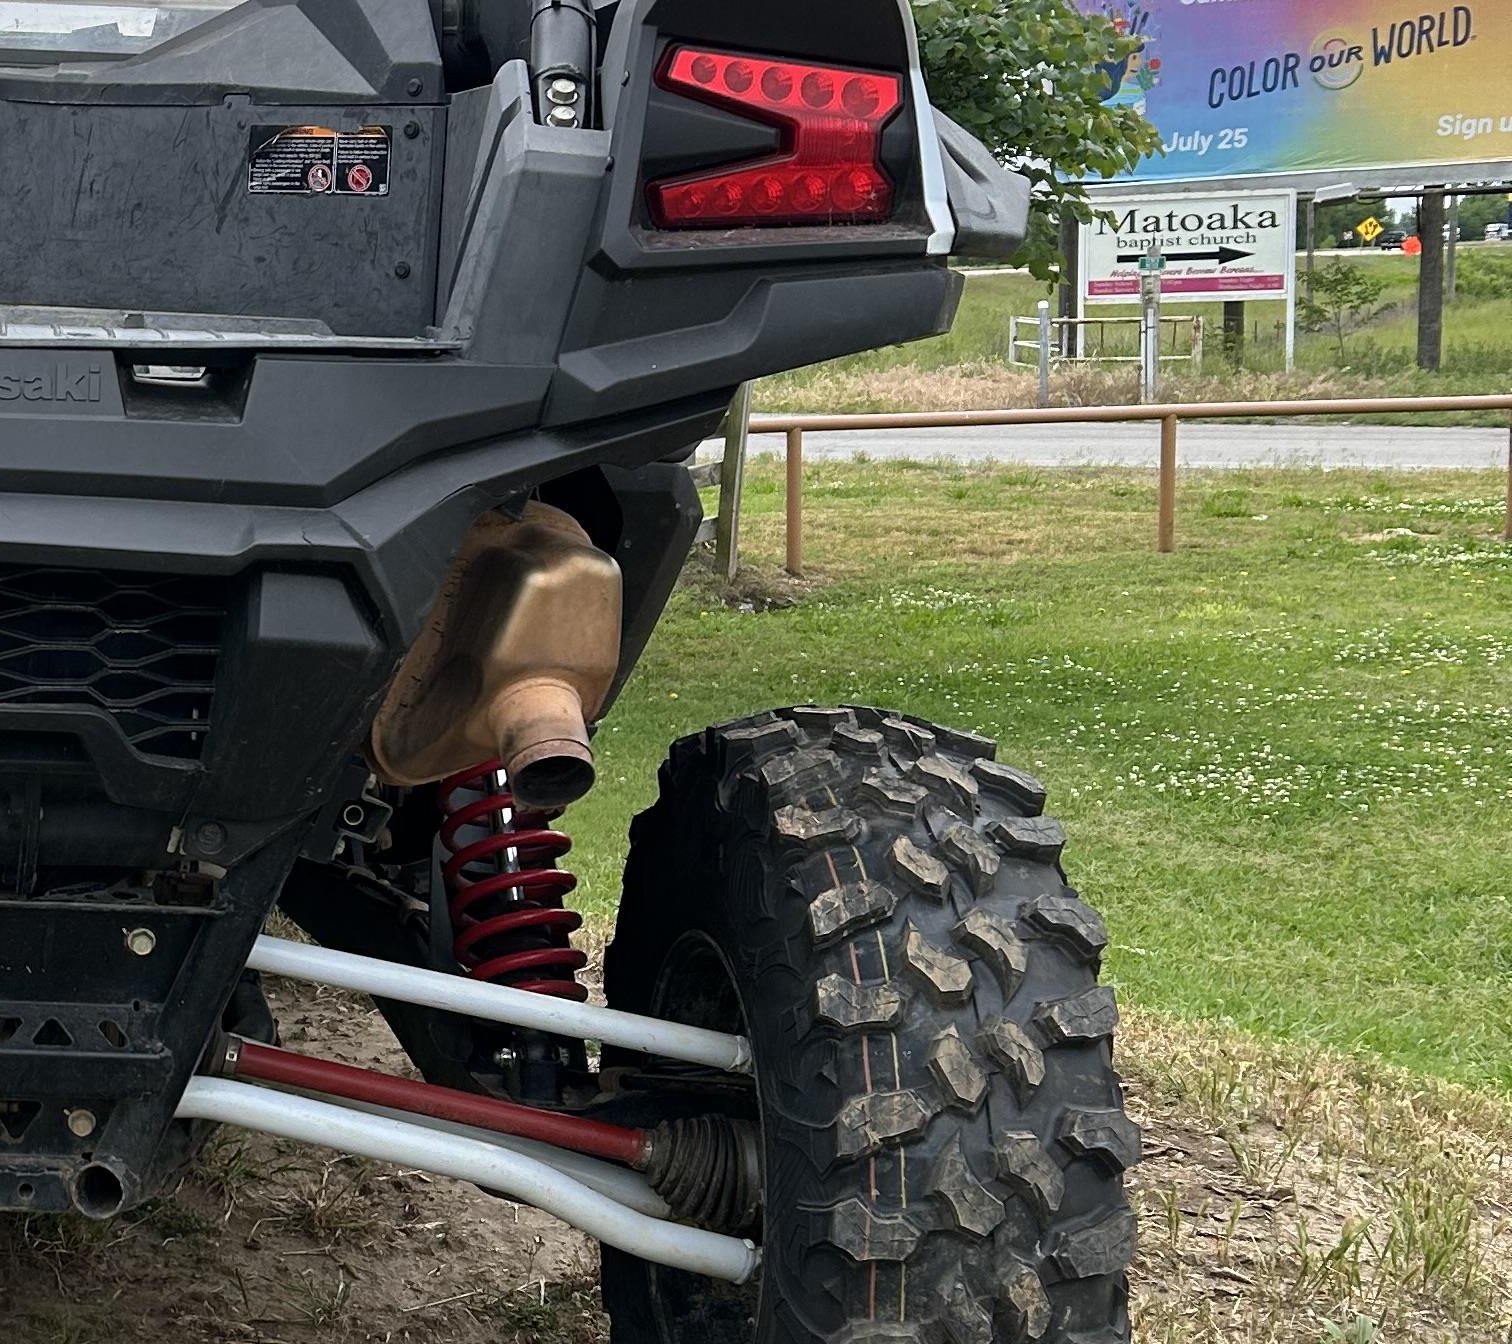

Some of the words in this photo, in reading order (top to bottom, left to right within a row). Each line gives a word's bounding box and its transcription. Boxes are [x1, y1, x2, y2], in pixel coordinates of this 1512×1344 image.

[1208, 52, 1302, 109] COLOR
[1309, 45, 1364, 73] OUR
[1372, 5, 1473, 67] WORLD
[1161, 131, 1214, 155] July
[1218, 127, 1249, 149] 25
[1436, 113, 1494, 141] Sign
[1095, 204, 1280, 235] Matoaka
[1117, 235, 1183, 250] baptist
[1189, 231, 1257, 246] church
